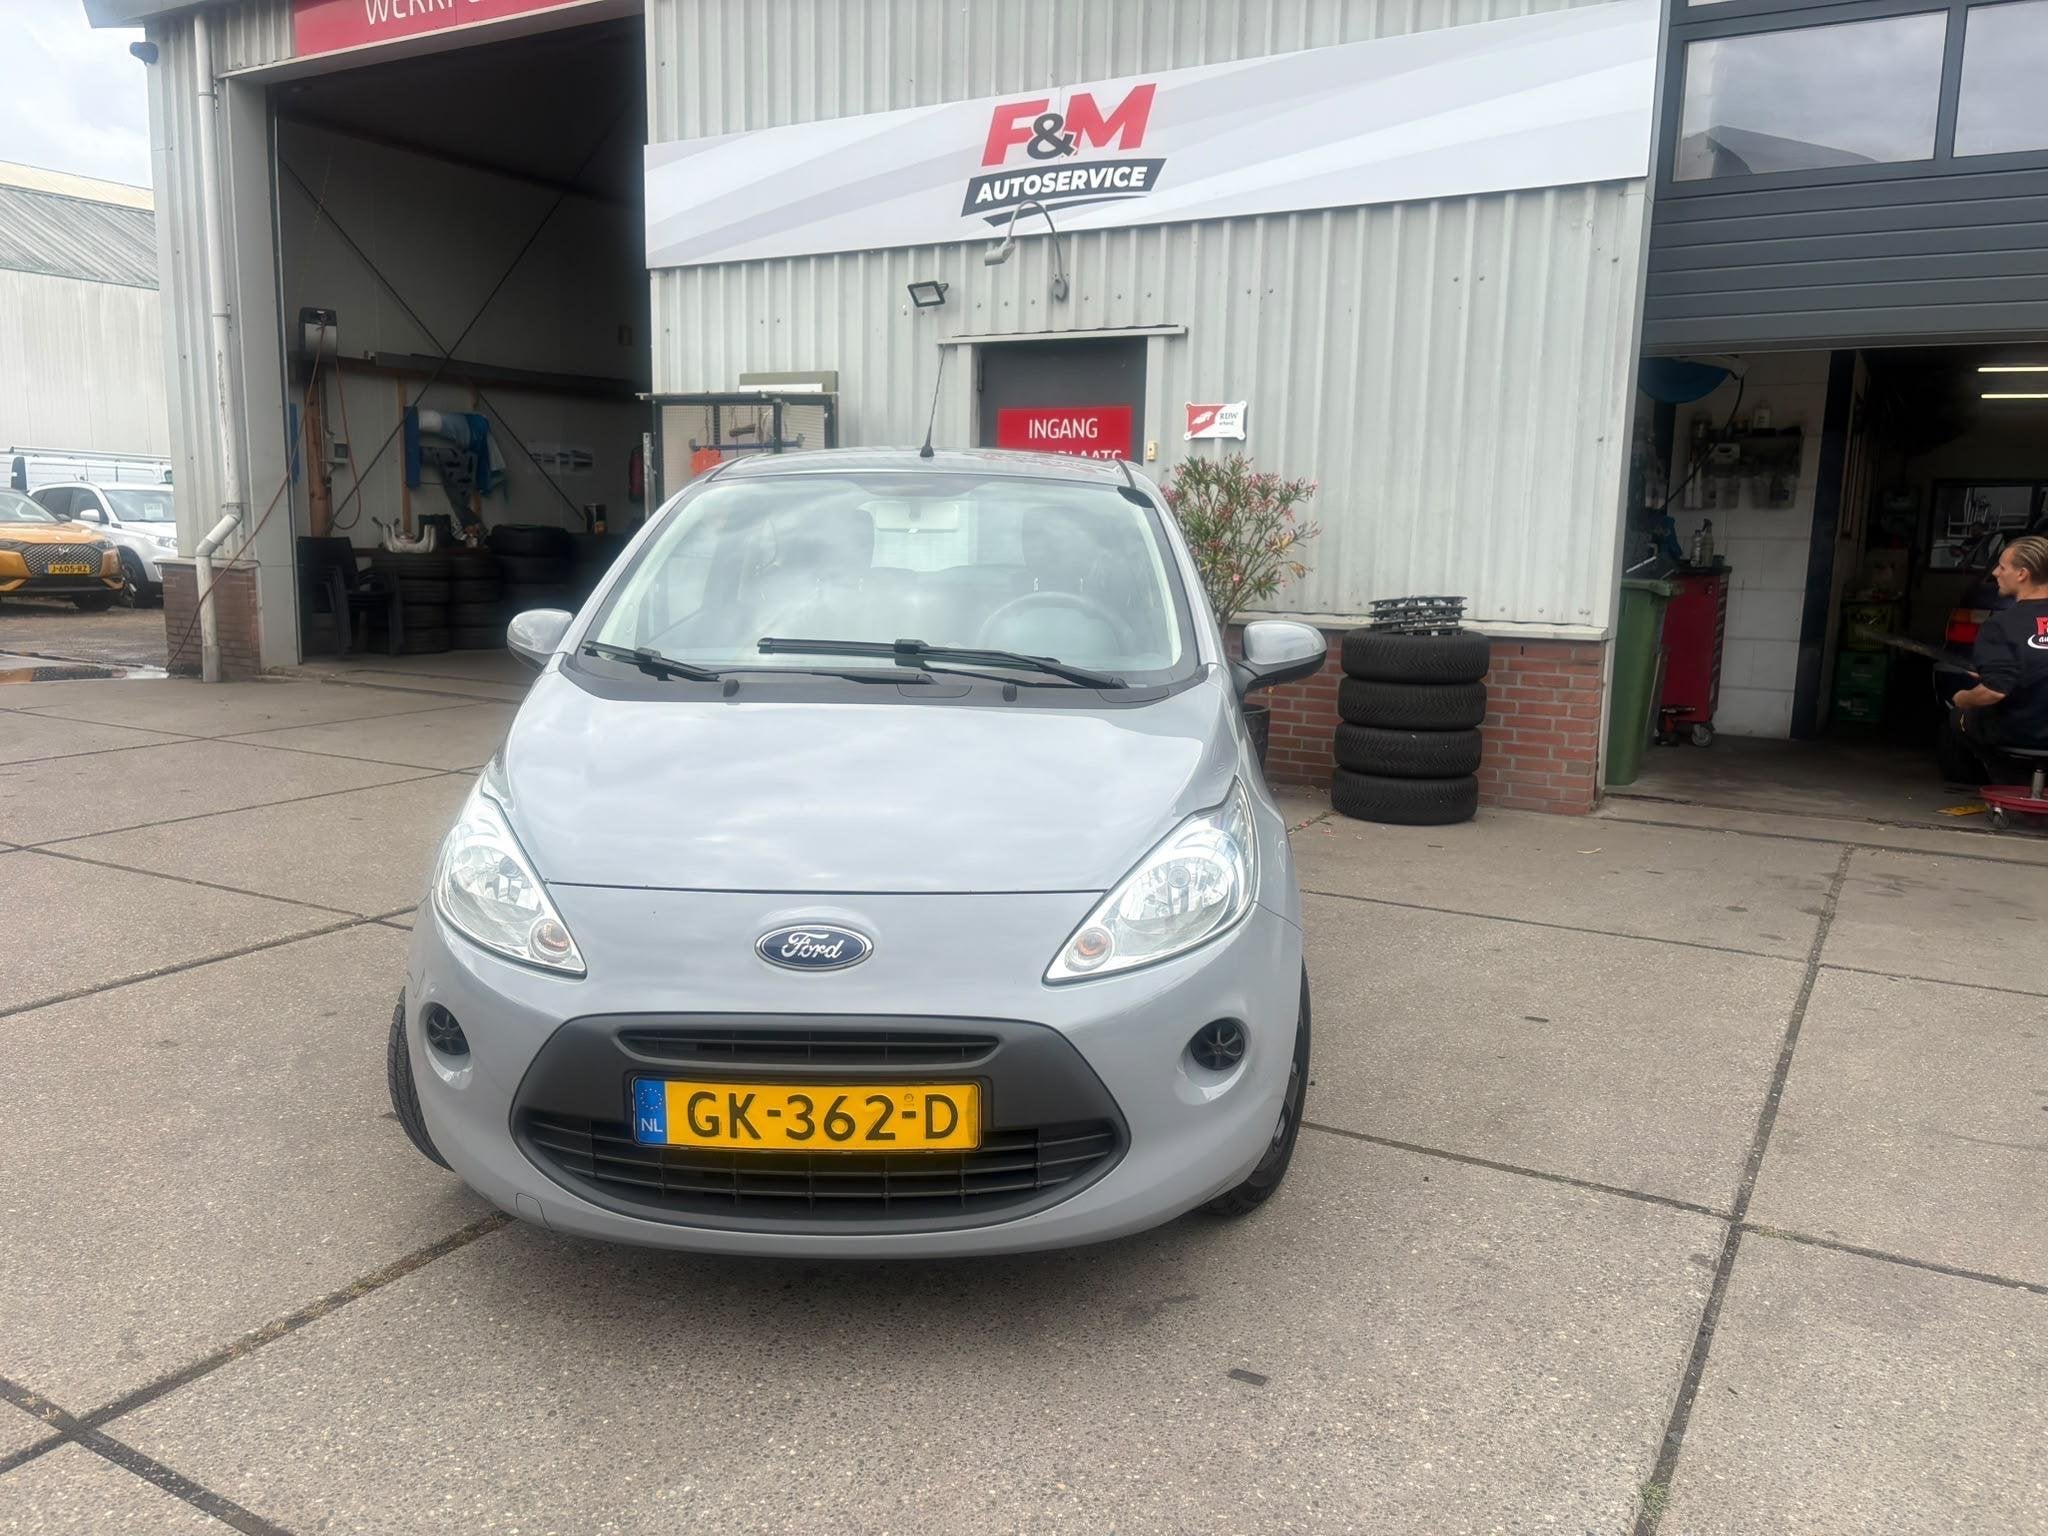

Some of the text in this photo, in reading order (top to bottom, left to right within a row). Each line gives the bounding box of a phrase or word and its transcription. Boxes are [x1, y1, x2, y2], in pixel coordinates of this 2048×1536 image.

[981, 83, 1157, 167] F&M
[975, 166, 1148, 205] AUTOSERVICE
[1028, 418, 1099, 439] INGANG
[781, 932, 845, 959] Ford
[641, 1118, 664, 1133] NL
[687, 1091, 959, 1142] GK-362-D
